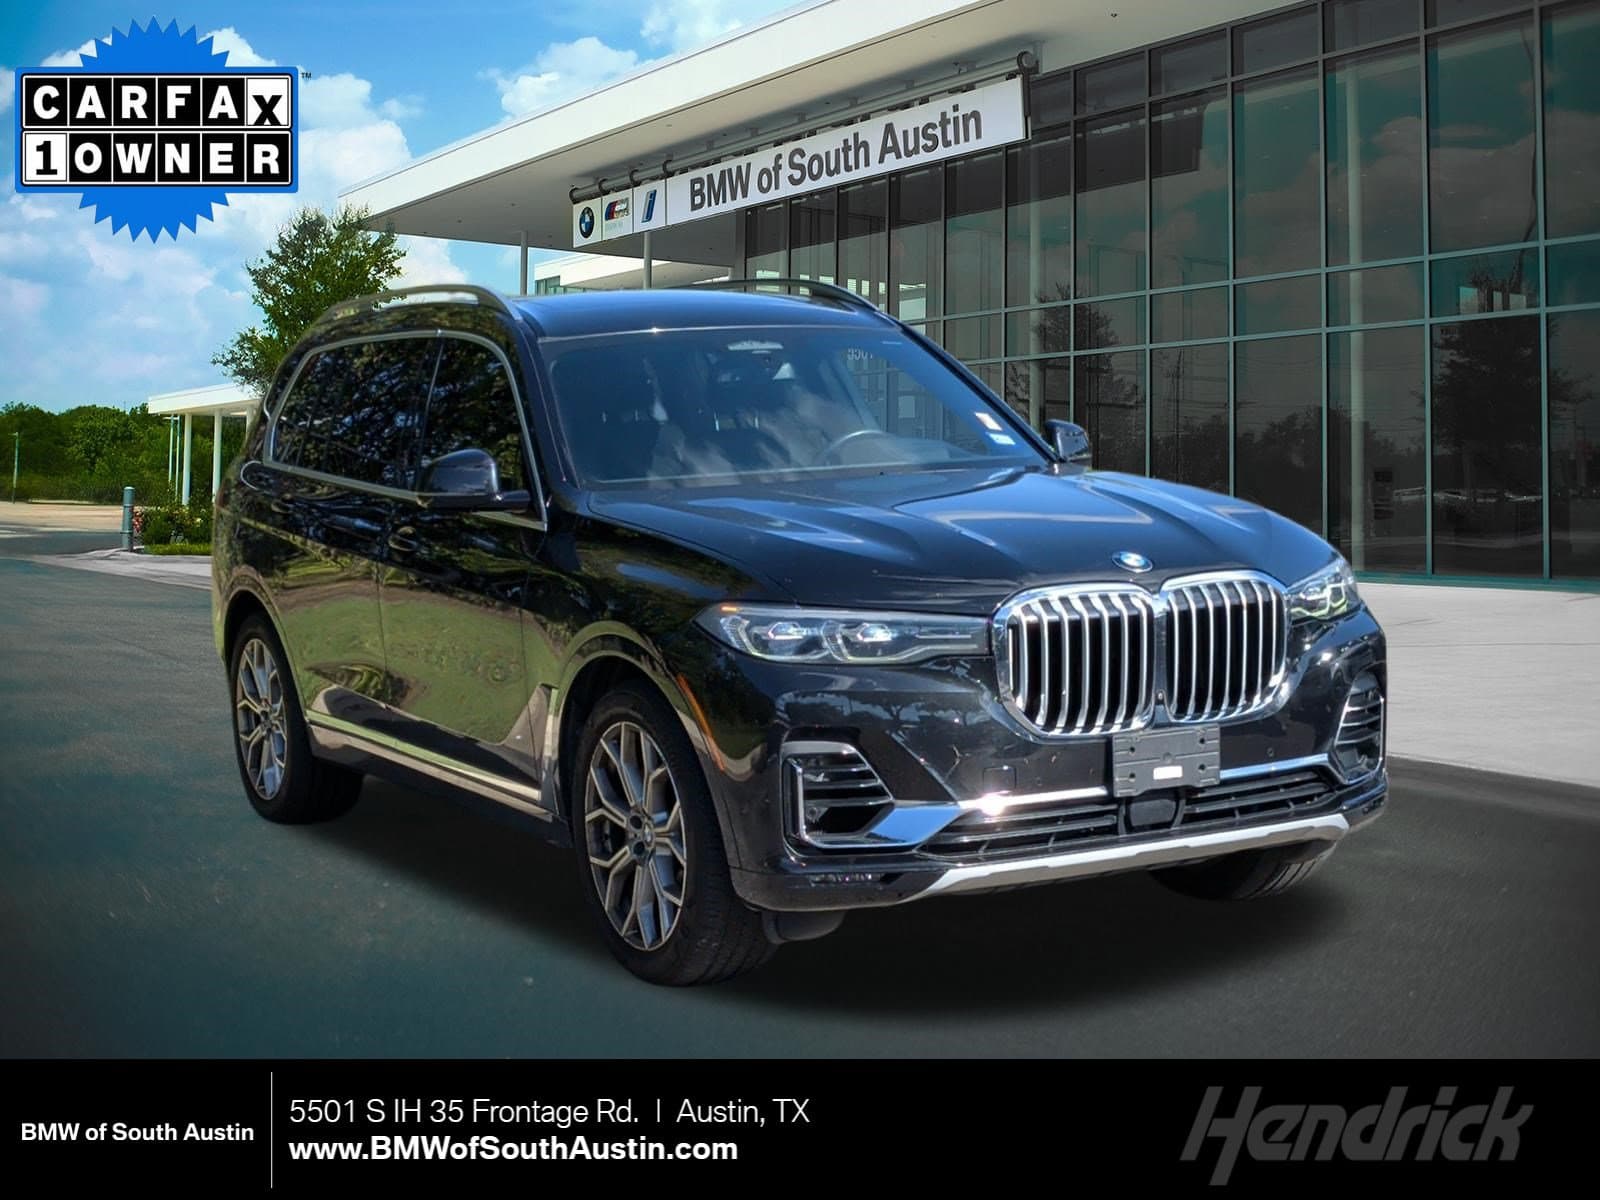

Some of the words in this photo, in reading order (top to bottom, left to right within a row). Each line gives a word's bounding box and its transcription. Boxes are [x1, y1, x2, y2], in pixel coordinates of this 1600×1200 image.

[689, 162, 752, 212] BMW
[757, 152, 783, 194] of
[787, 132, 870, 186] South
[878, 103, 983, 165] Austin
